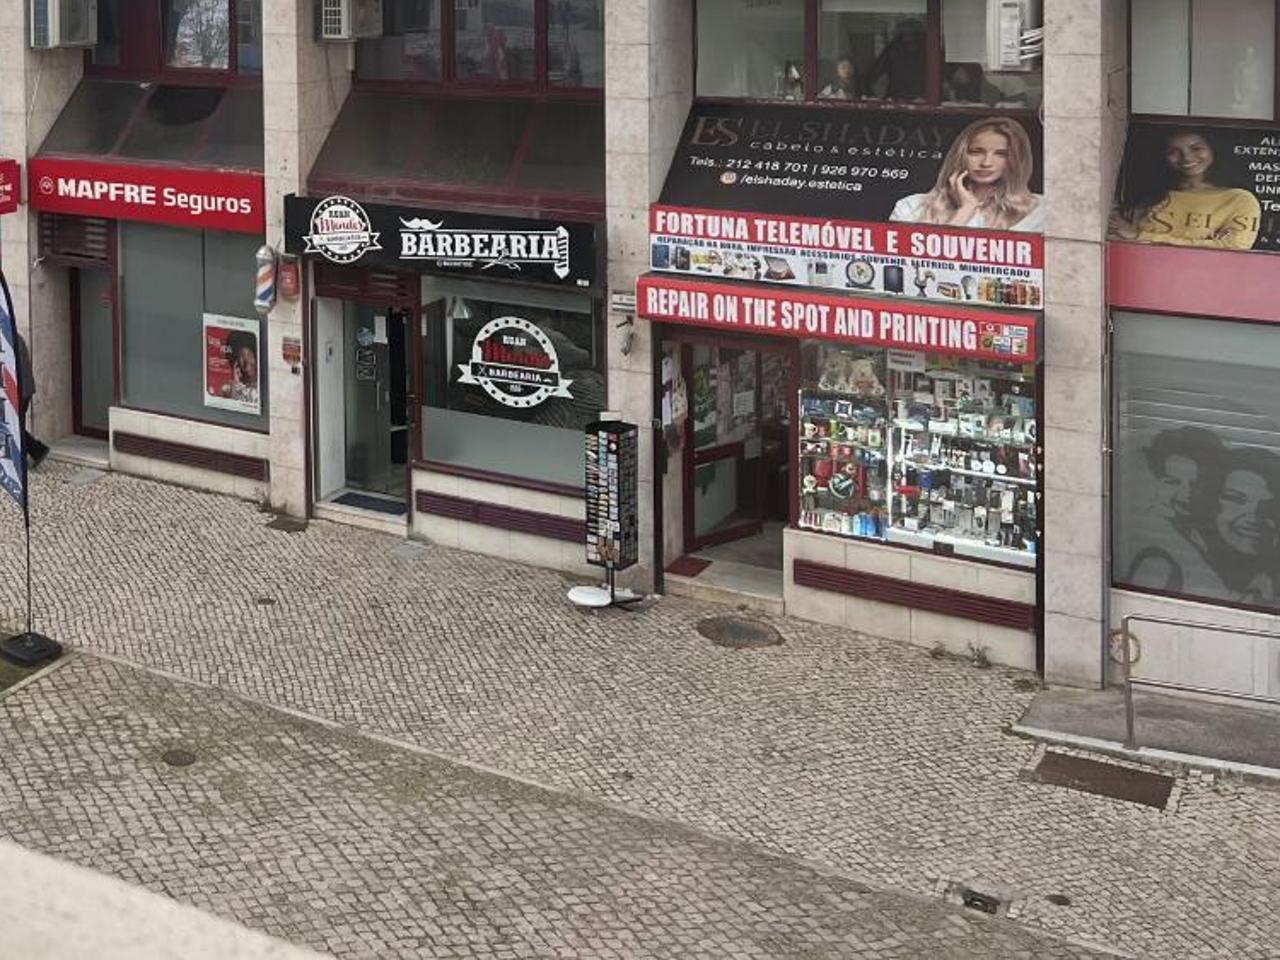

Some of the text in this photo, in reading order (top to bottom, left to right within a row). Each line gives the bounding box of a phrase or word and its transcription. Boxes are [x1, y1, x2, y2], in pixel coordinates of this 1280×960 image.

[750, 141, 824, 153] cabelo
[726, 158, 752, 169] 212
[754, 160, 780, 171] 418
[784, 161, 808, 172] 701
[821, 164, 847, 176] 926
[850, 166, 878, 178] 970
[57, 177, 251, 215] MAPFRE Seguros
[400, 232, 561, 259] BARBEARIA
[656, 210, 1032, 266] FORTUNA TELEMÓVEL E SOUVENIR
[959, 263, 1030, 278] MINIMERCADO
[646, 287, 977, 350] REPAIR ON THE SPOT AND PRINTING
[489, 368, 542, 382] BARBEARIA
